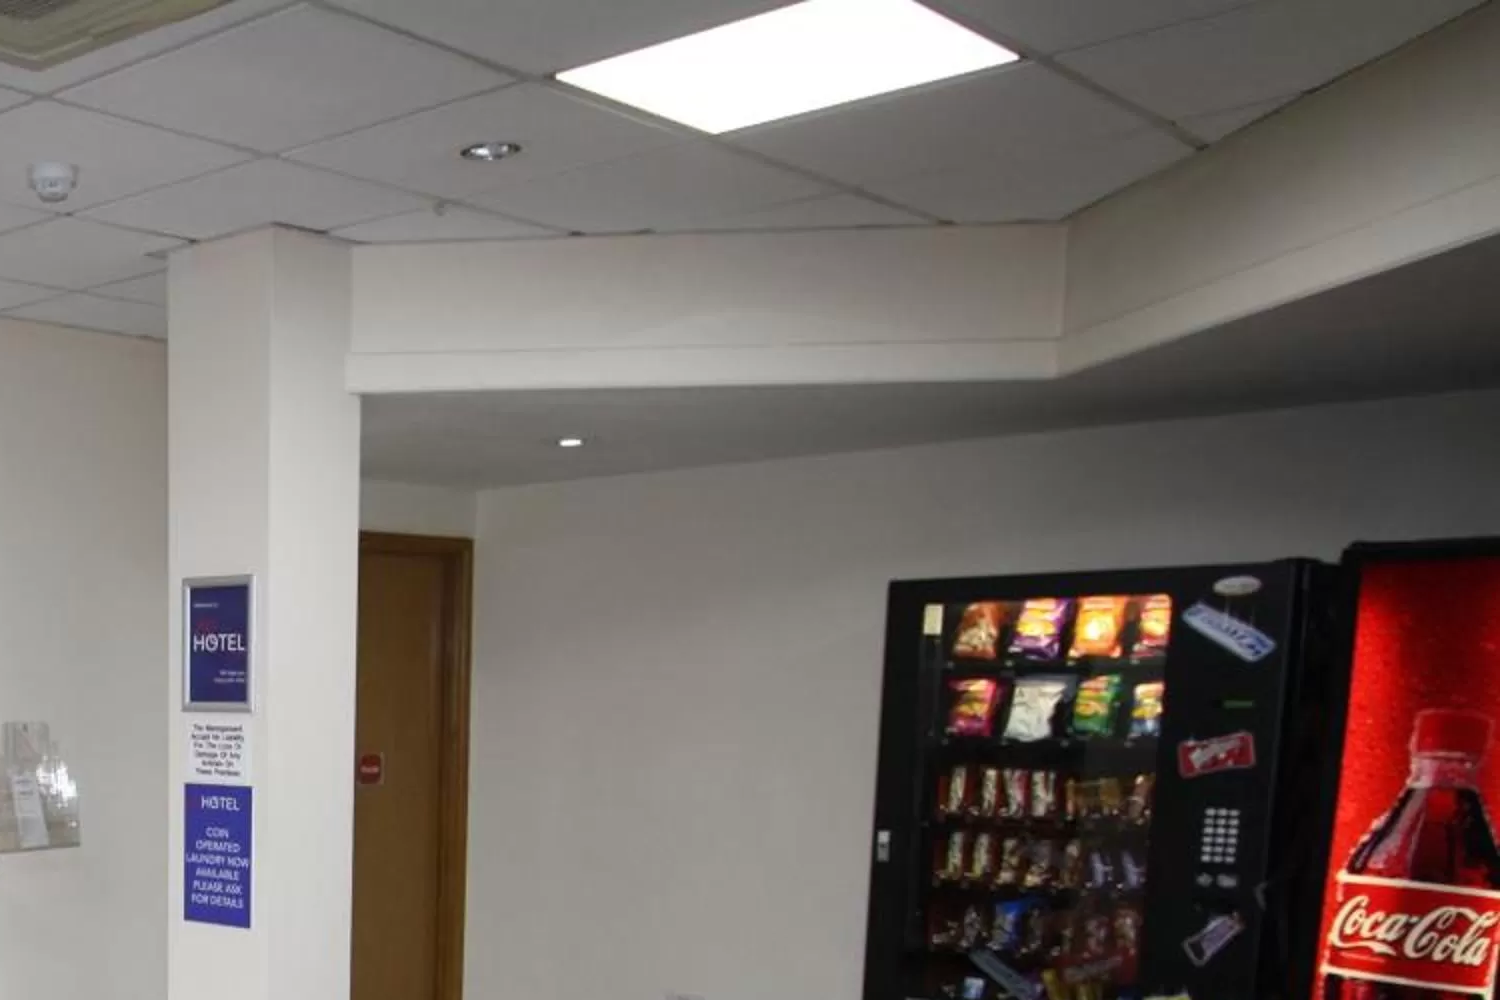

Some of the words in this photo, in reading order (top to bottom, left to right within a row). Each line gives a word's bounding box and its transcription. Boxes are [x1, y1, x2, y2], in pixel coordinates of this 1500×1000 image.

[193, 632, 245, 652] HOTEL
[201, 796, 240, 811] HOTEL
[205, 827, 229, 839] COIN
[195, 840, 241, 853] OPERATED
[186, 852, 225, 865] LAUNDRY
[227, 856, 249, 868] NOW
[195, 867, 240, 881] AVAILABLE
[193, 880, 224, 893] PLEASE
[225, 884, 243, 895] ASK
[191, 893, 209, 904] FOR
[210, 896, 244, 909] DETAILS
[1329, 895, 1500, 967] Coca-Cola
